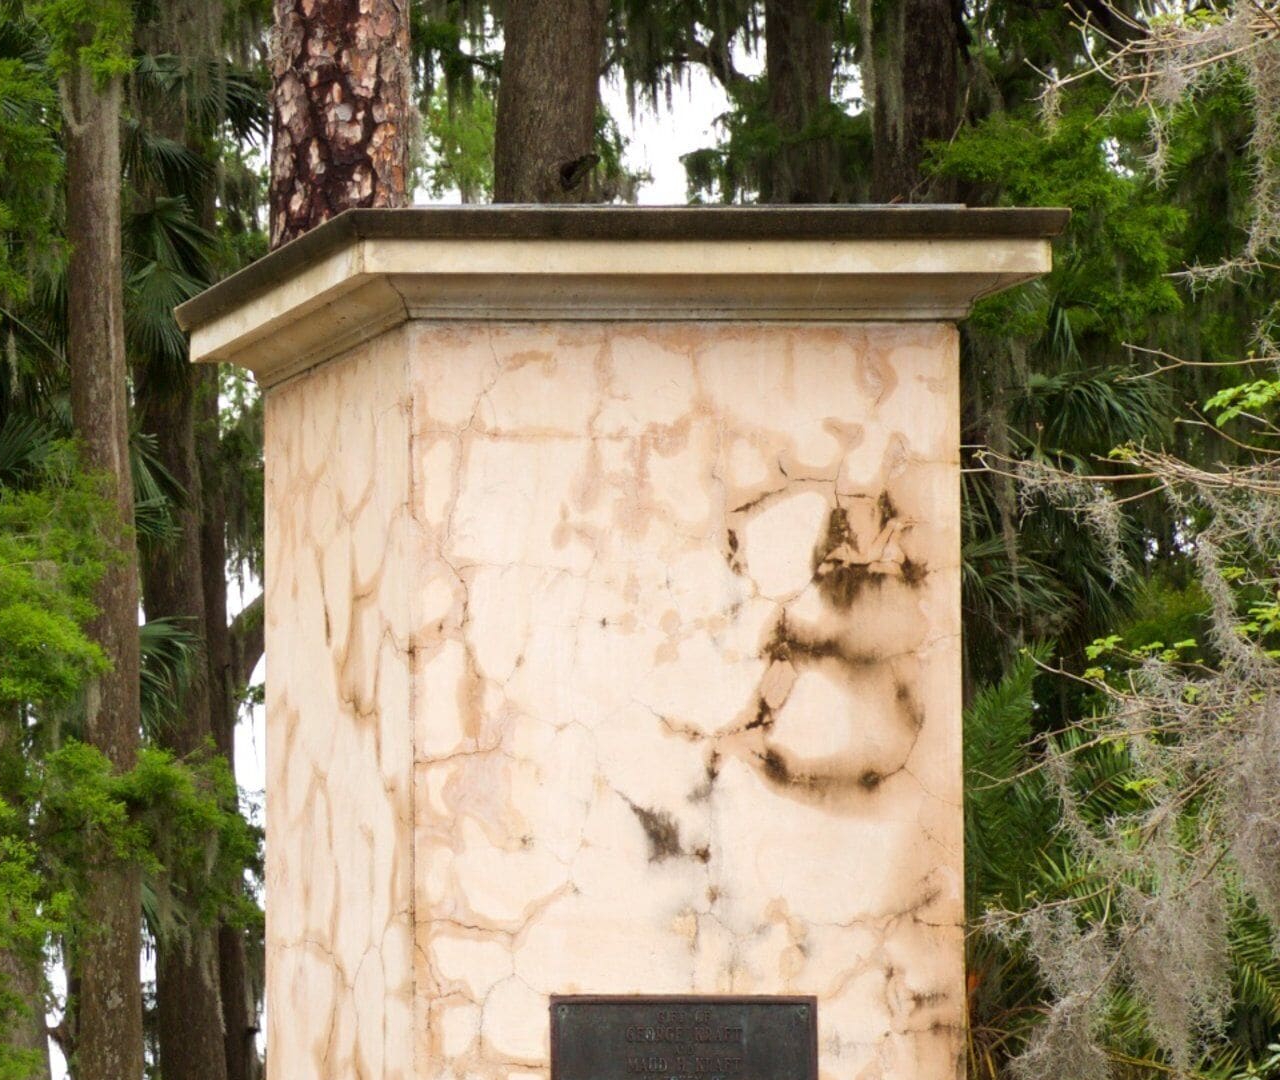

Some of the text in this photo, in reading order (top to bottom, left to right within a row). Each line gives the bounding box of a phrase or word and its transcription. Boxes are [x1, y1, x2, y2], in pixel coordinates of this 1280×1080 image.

[626, 1026, 744, 1042] GEORGE KRAFT
[626, 1057, 668, 1072] MAUD
[696, 1057, 744, 1072] KRAFT
